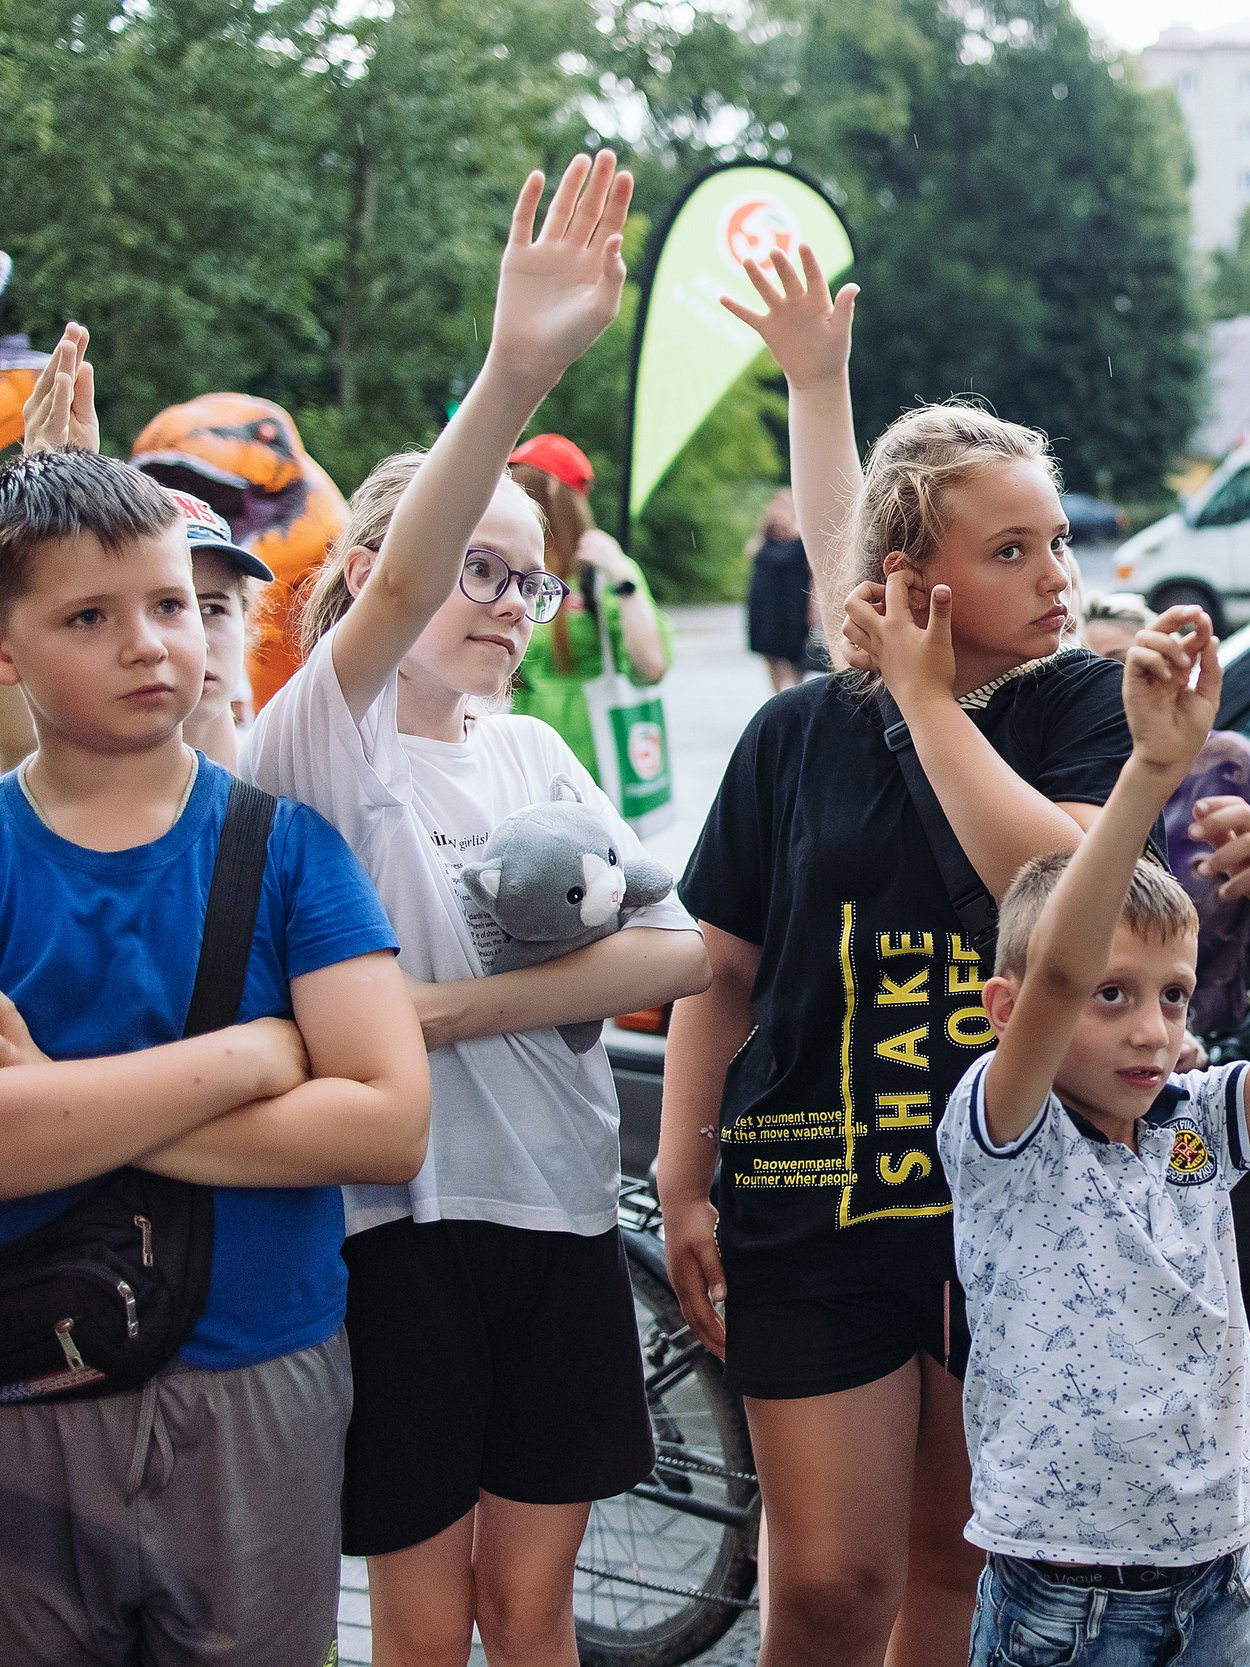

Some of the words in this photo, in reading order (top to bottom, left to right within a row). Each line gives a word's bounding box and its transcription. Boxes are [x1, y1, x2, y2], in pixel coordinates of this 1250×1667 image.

[876, 930, 934, 1186] SHAKE
[756, 1111, 805, 1127] youment
[808, 1110, 842, 1122] move
[734, 1129, 757, 1141] the
[760, 1127, 790, 1139] move
[792, 1125, 836, 1140] wapter
[753, 1157, 842, 1171] Daowenmpare
[734, 1172, 781, 1186] Yourner
[783, 1172, 817, 1186] wher
[819, 1171, 859, 1187] people
